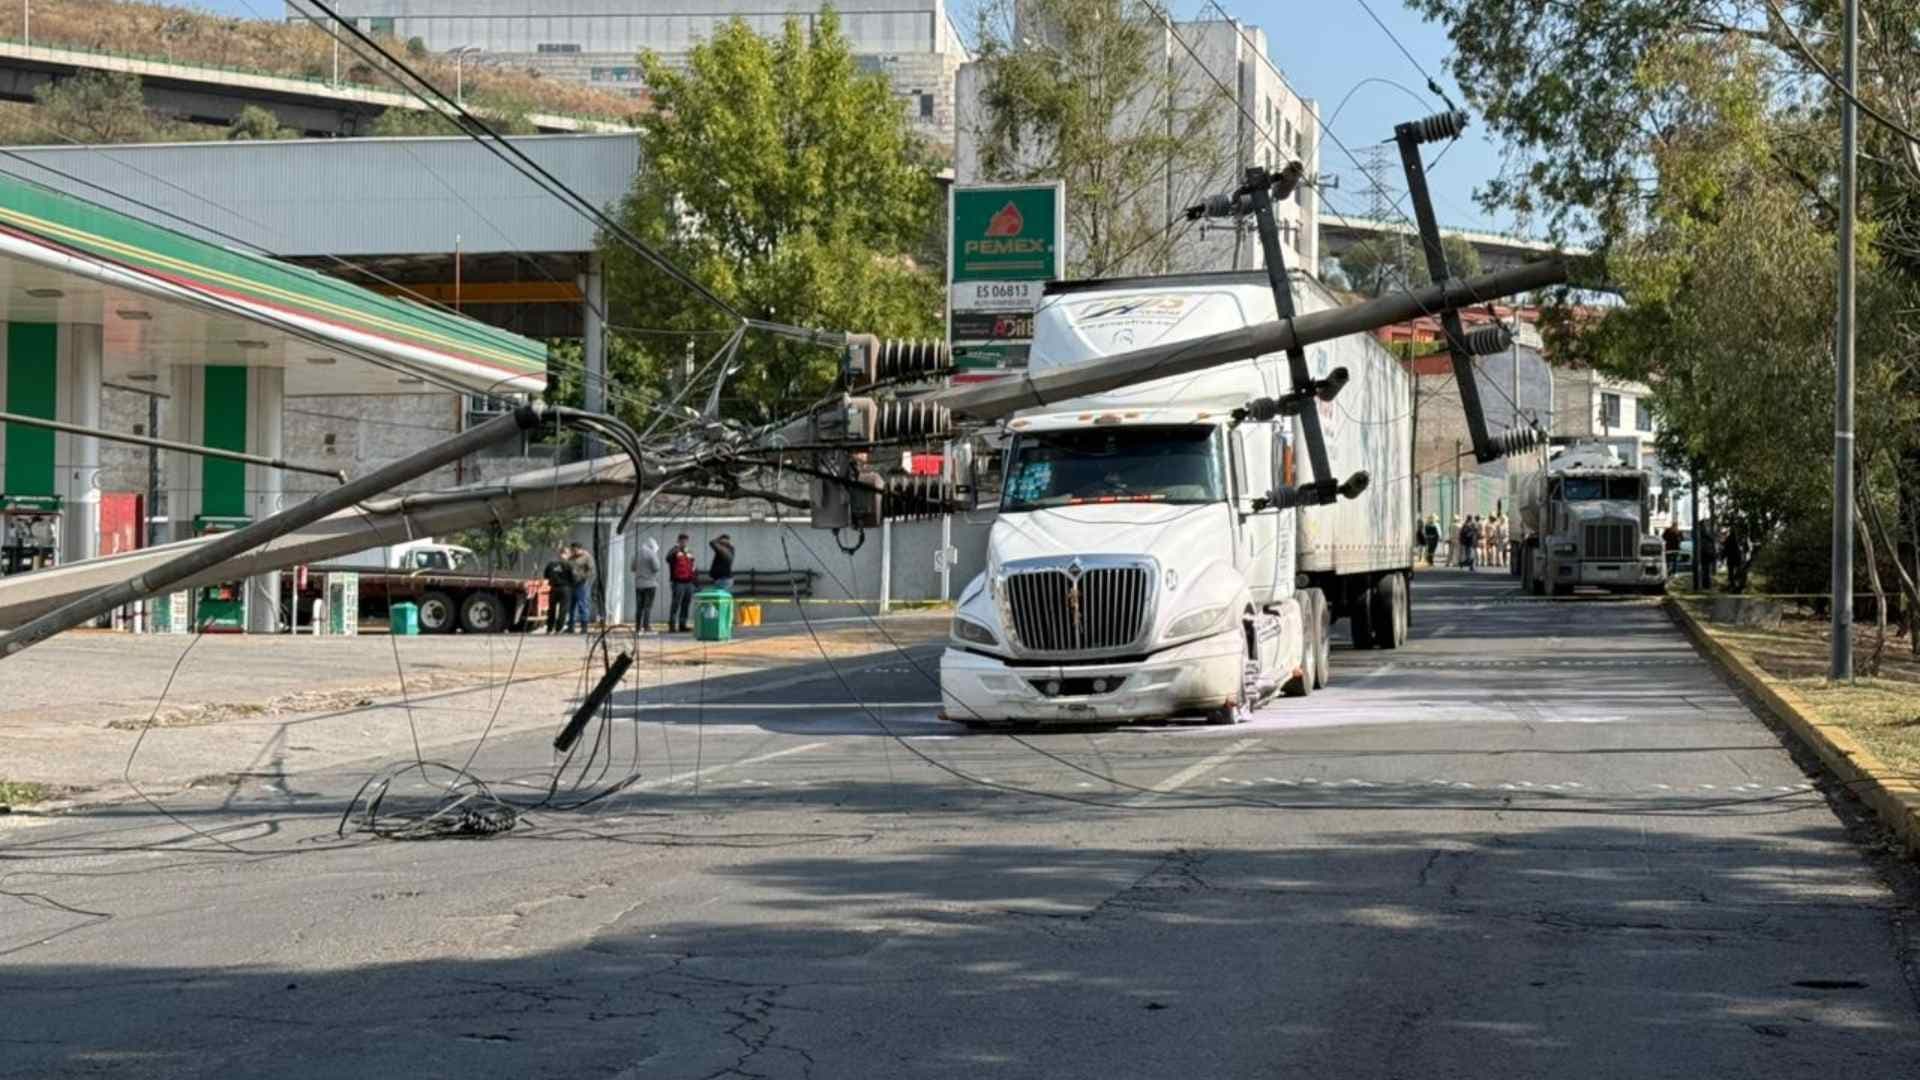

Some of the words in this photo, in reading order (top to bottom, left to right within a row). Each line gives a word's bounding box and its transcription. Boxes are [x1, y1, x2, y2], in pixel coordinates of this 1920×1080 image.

[964, 239, 1045, 255] PEMEX
[976, 285, 990, 298] ES
[991, 284, 1029, 297] 06813
